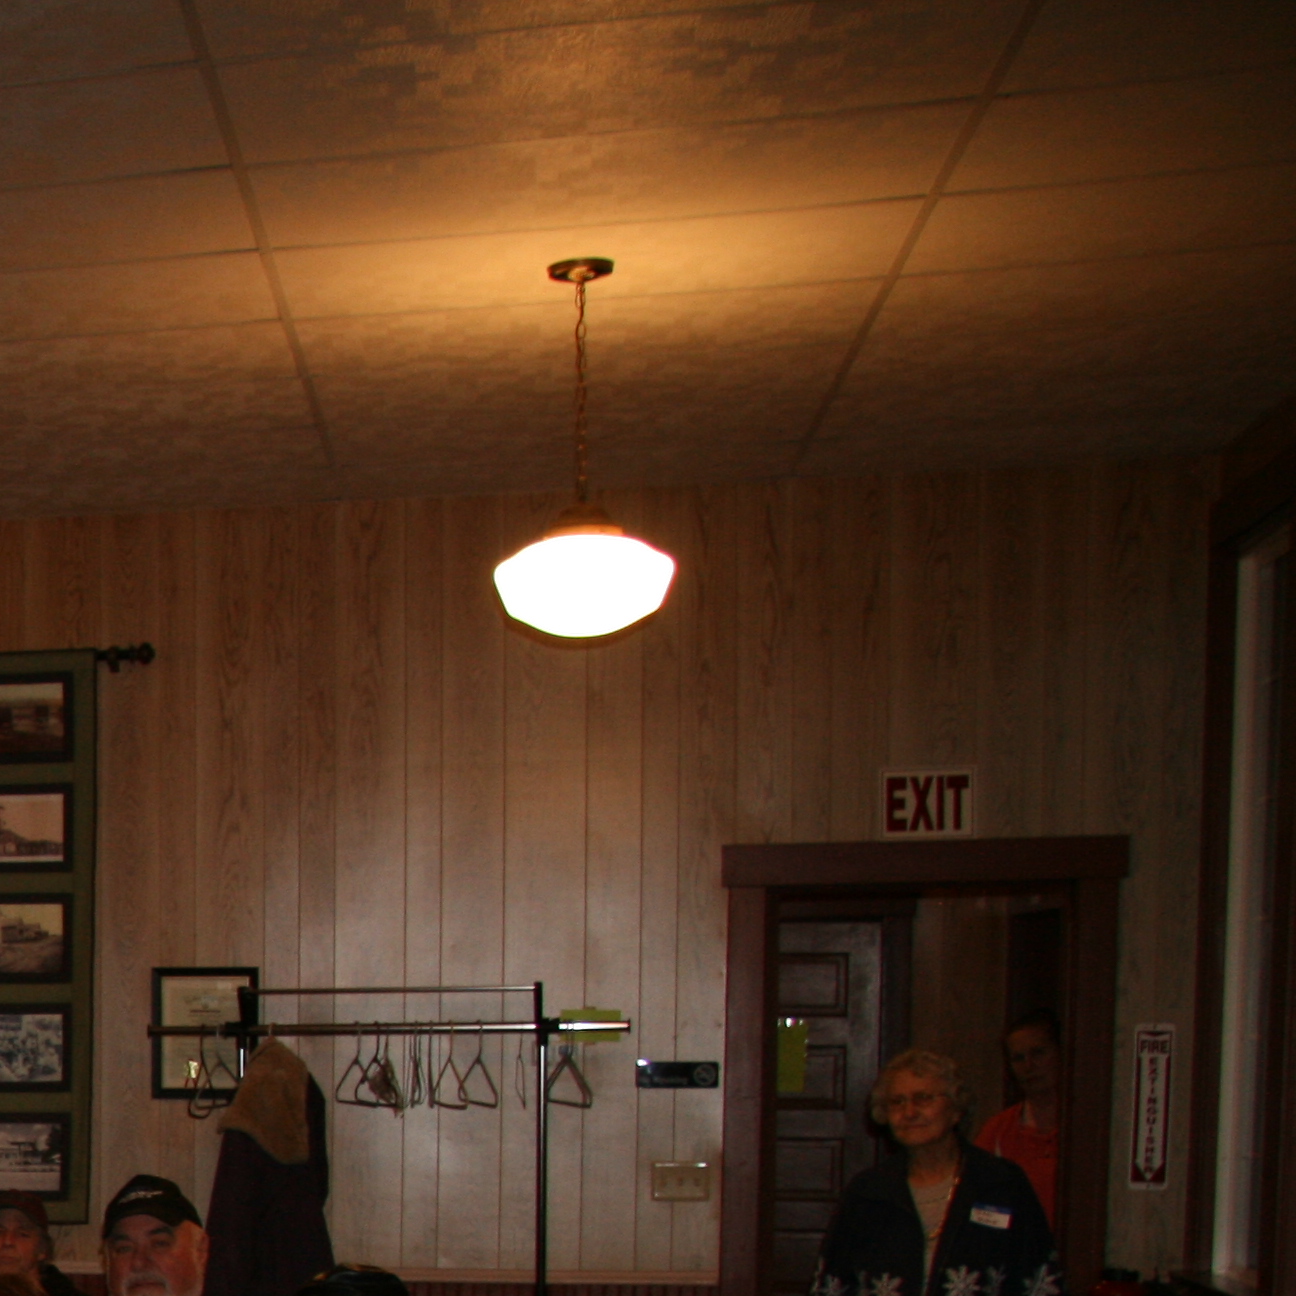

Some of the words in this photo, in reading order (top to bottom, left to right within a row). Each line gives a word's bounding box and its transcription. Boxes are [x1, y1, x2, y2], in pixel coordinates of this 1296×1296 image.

[886, 776, 969, 831] EXIT
[1140, 1040, 1169, 1054] FIRE
[1144, 1057, 1158, 1172] EXTINGUISHER
